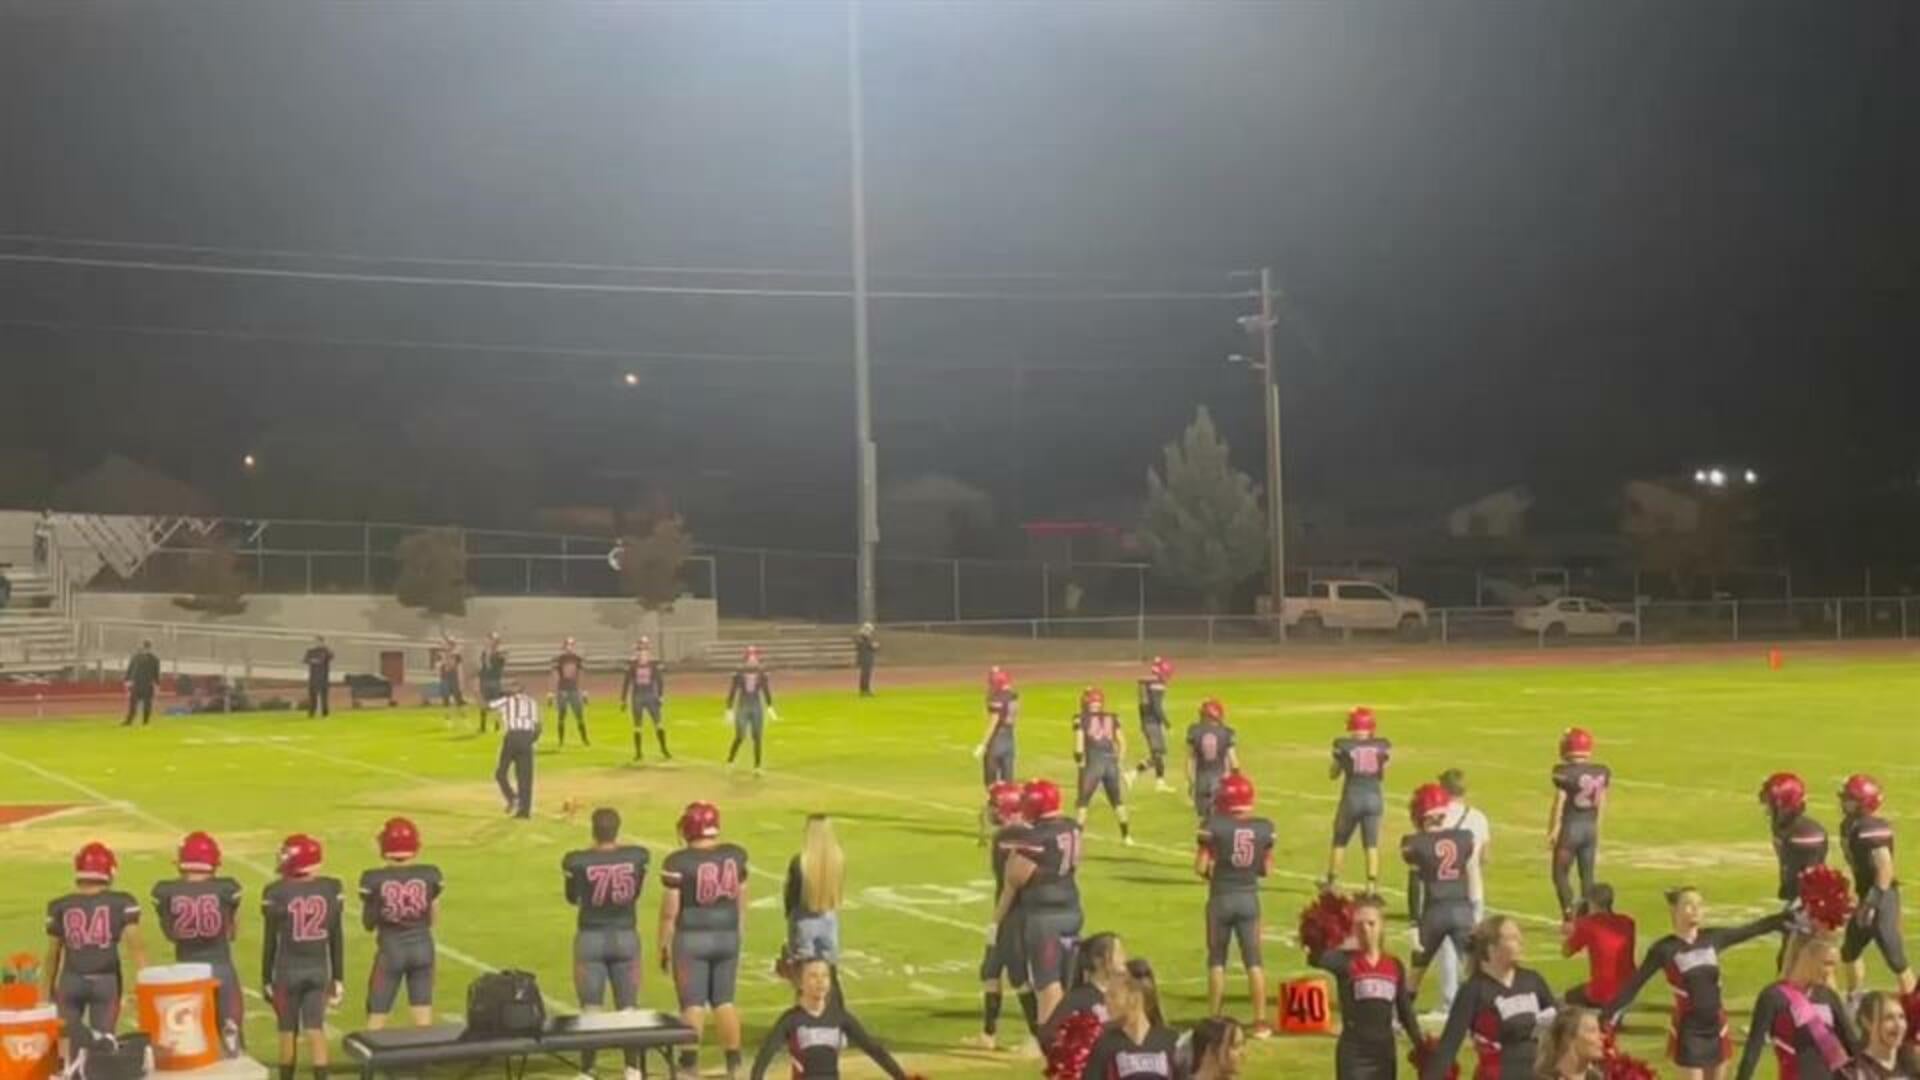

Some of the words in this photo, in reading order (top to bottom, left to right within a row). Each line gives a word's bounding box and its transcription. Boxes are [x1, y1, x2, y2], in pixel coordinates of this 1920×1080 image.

[1231, 829, 1255, 868] 5
[1434, 838, 1460, 881] 2
[586, 862, 636, 907] 75
[63, 904, 112, 950] 84
[170, 894, 222, 940] 26
[287, 895, 329, 942] 12
[165, 999, 204, 1036] G
[1287, 985, 1325, 1024] 40
